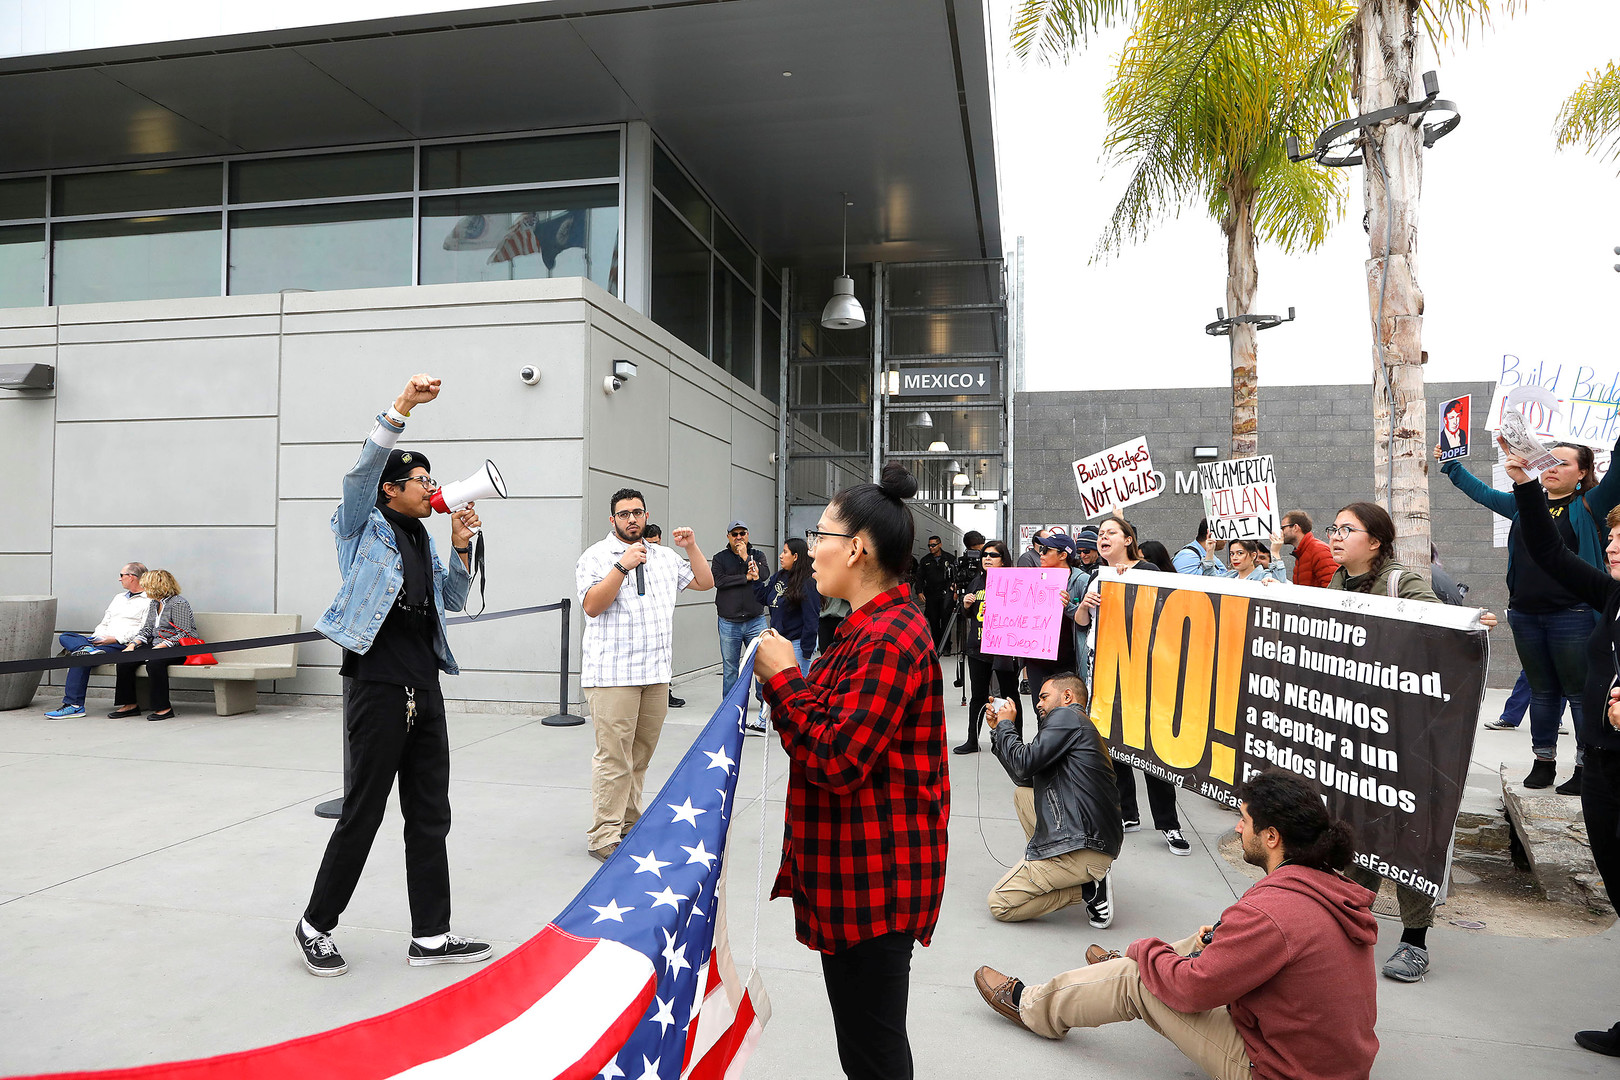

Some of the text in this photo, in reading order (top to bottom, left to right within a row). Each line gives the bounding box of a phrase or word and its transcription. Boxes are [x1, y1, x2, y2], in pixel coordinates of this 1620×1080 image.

[904, 373, 974, 389] MEXICO
[1076, 445, 1149, 484] Build Bridges
[1441, 446, 1466, 460] DOPE
[1197, 456, 1275, 490] MAKE AMERICA
[1209, 514, 1273, 540] AGAIN
[985, 613, 1053, 631] WELCOME IN
[1283, 613, 1367, 647] nombre
[1089, 580, 1251, 786] NO!
[1299, 644, 1451, 702] humanidad,
[1248, 672, 1390, 734] NOS NEGAMOS
[1246, 706, 1399, 773] a aceptar a un
[1244, 732, 1317, 780] Estados
[1319, 759, 1417, 814] Unidos
